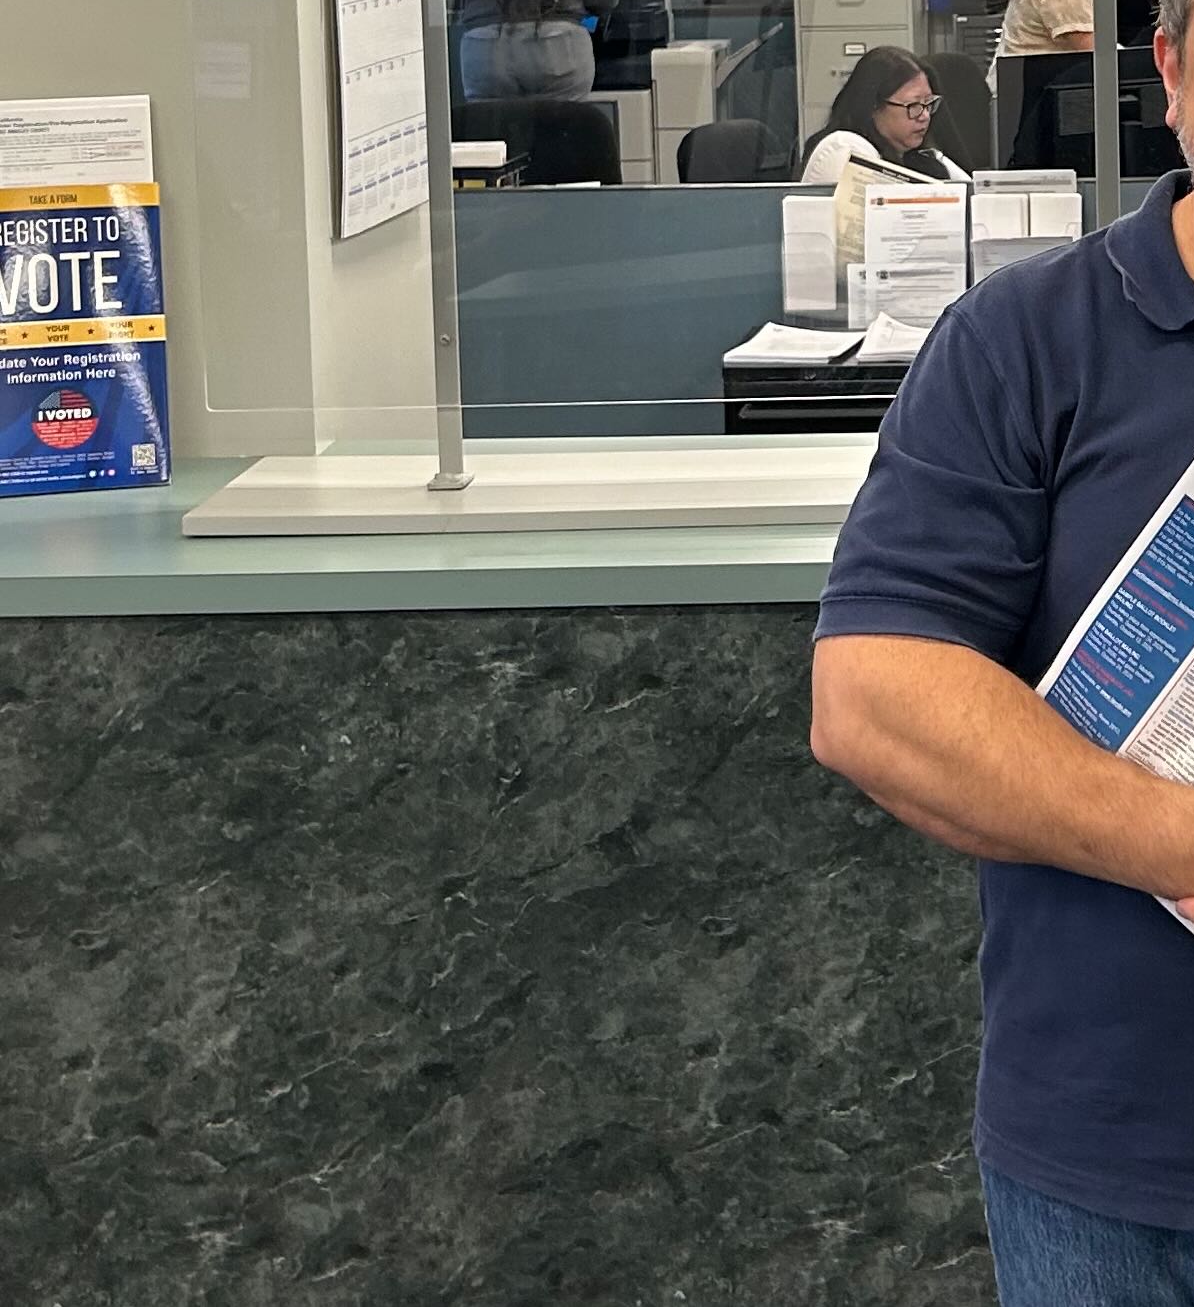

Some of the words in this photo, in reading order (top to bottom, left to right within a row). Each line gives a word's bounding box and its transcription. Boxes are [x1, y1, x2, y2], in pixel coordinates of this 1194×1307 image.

[29, 195, 47, 205] TAKE
[50, 195, 55, 204] A
[57, 194, 78, 204] FORM
[92, 216, 120, 242] TO
[0, 250, 122, 316] VOTE
[46, 324, 70, 333] YOUR
[47, 334, 69, 342] VOTE
[0, 357, 27, 370] date
[30, 355, 60, 368] Your
[63, 350, 141, 367] Registration
[7, 370, 82, 385] Information
[86, 368, 116, 380] Here
[44, 407, 92, 421] VOTED
